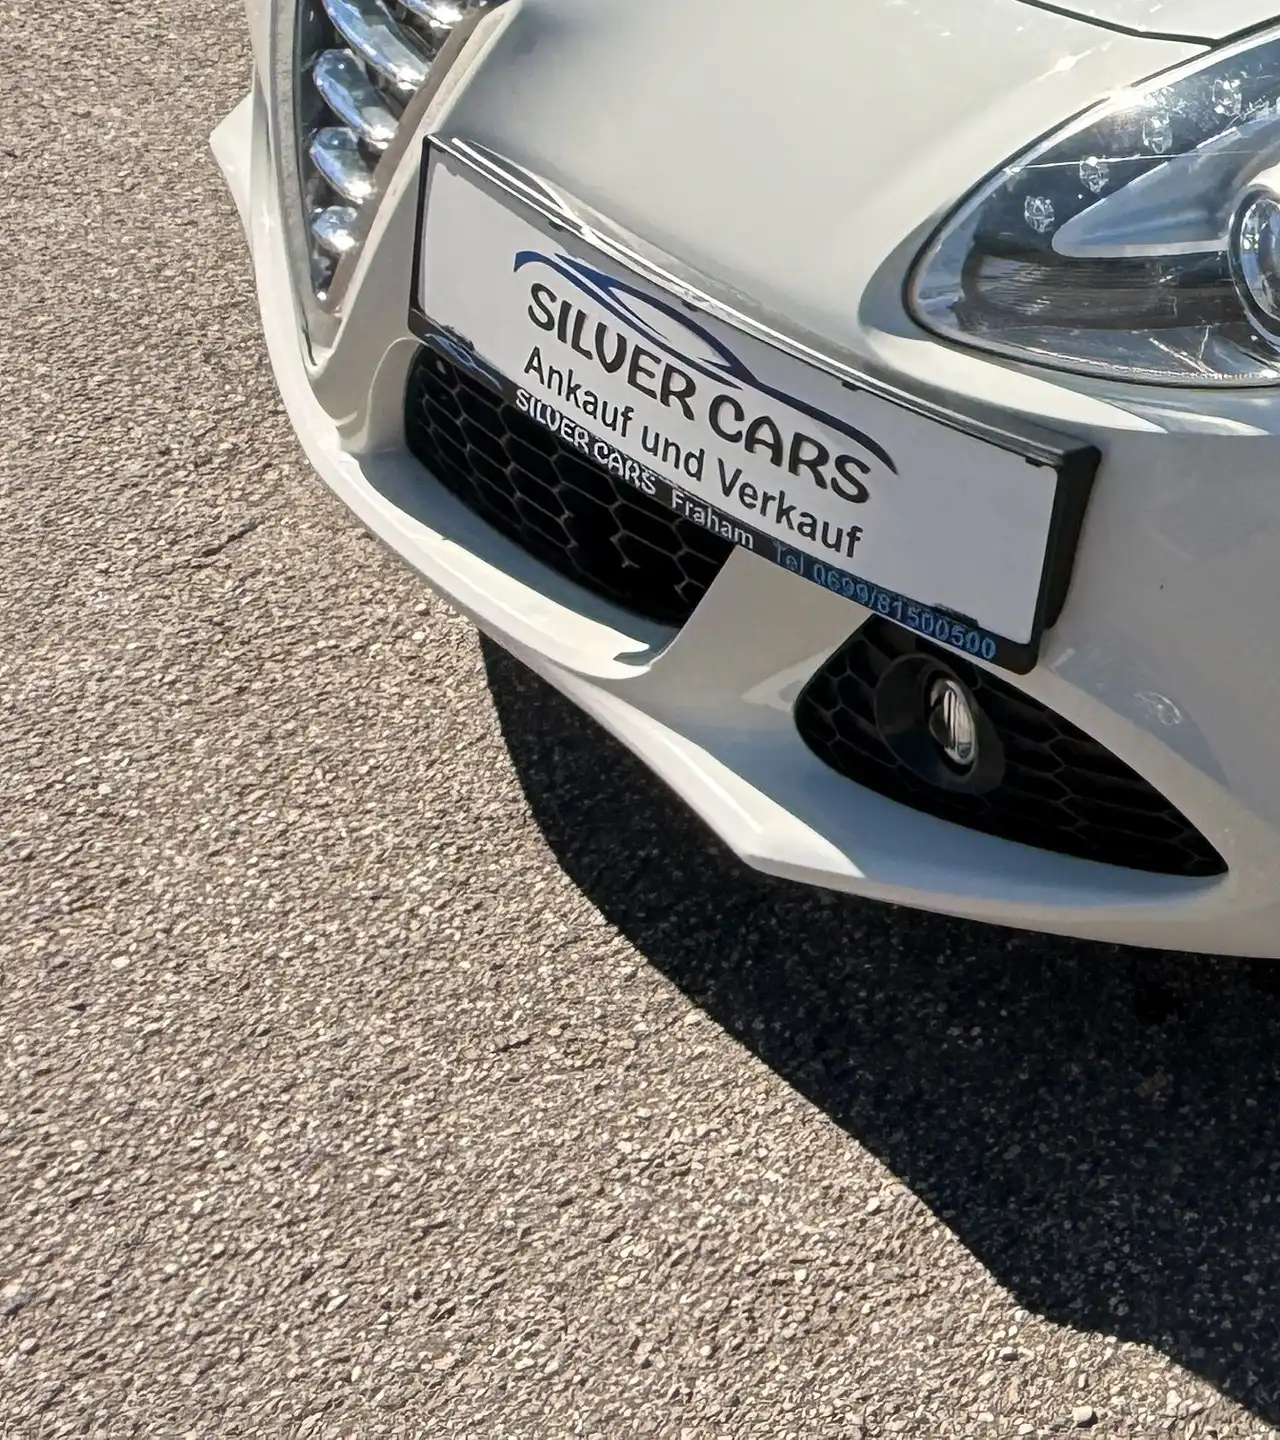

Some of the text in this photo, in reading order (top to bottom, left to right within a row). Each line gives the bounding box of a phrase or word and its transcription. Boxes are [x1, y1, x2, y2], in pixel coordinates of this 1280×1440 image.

[515, 388, 754, 550] SILVER CARS Fraham
[523, 346, 864, 559] Ankauf und Verkauf
[526, 283, 870, 504] SILVER CARS
